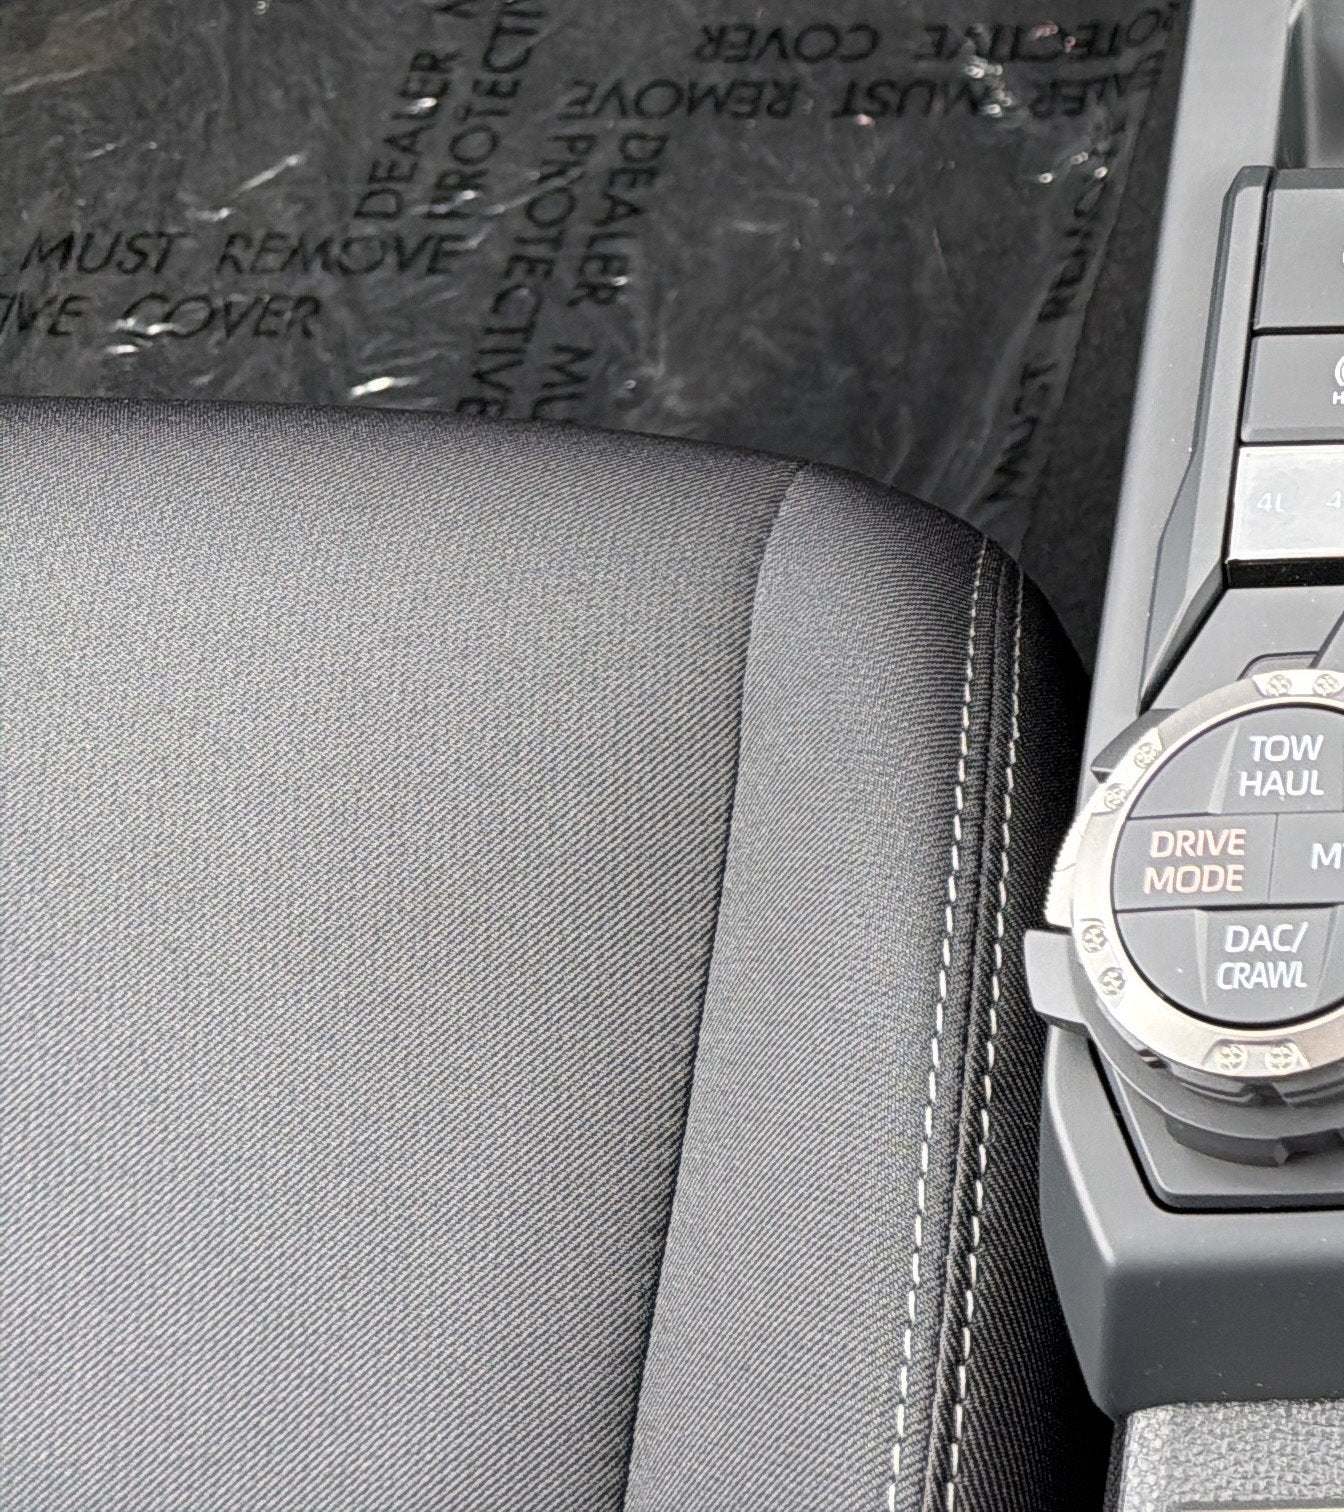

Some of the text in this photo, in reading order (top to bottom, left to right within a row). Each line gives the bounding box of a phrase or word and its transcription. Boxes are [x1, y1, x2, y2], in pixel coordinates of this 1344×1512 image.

[694, 21, 882, 67] COVER
[556, 77, 801, 122] REMOVE
[832, 77, 991, 121] MUST
[356, 50, 458, 220] DEALER
[568, 132, 671, 308] DEALER
[20, 229, 470, 276] MUST REMOVE
[457, 132, 599, 421] PROTECTIVE
[1249, 734, 1325, 762] TOW
[1237, 769, 1324, 798] HAUL
[1149, 827, 1247, 858] DRIVE
[1143, 863, 1245, 895] MODE
[1224, 921, 1309, 954] DAC/
[1216, 961, 1308, 989] CRAWL
